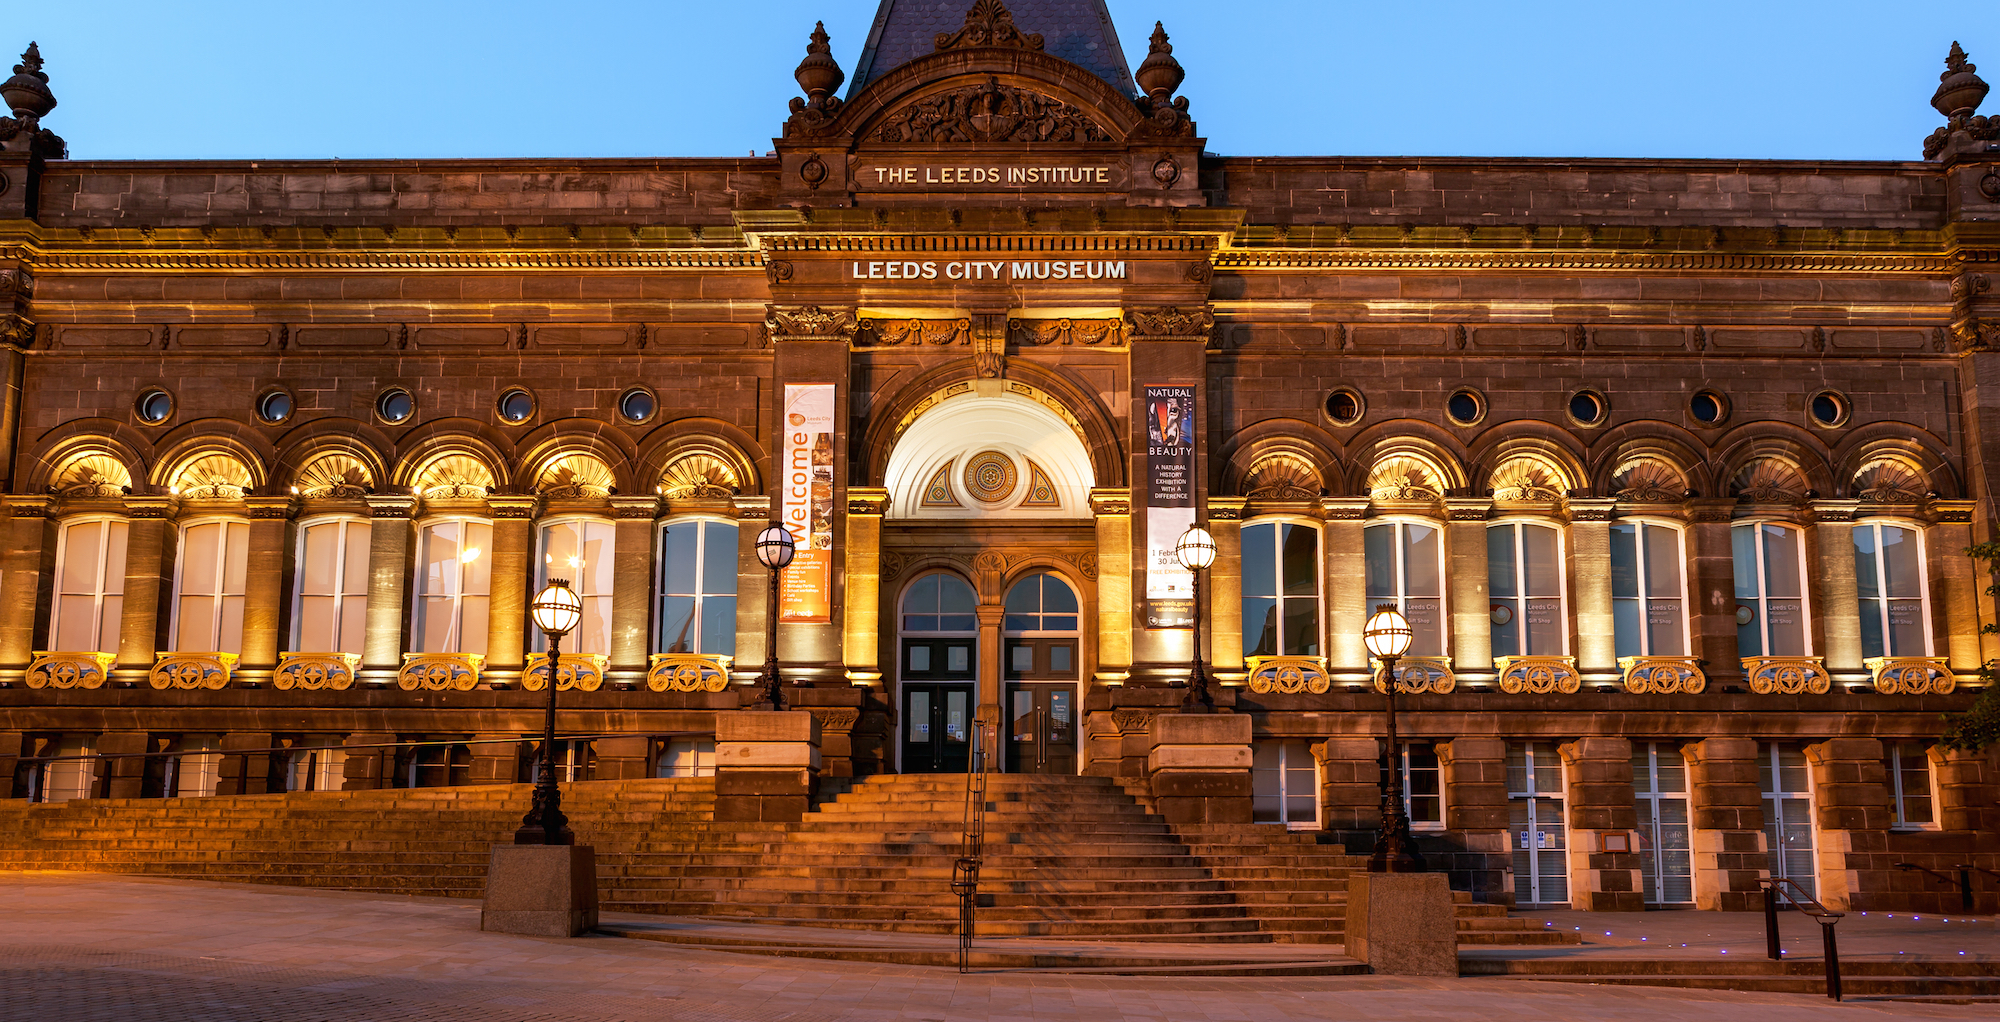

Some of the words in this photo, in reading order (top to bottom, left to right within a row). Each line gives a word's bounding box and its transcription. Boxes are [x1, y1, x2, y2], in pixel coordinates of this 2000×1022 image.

[875, 167, 918, 183] THE
[926, 167, 1001, 183] LEEDS
[1007, 167, 1109, 183] INSTITUTE
[853, 261, 938, 280] LEEDS
[945, 261, 1005, 280] CITY
[1012, 261, 1126, 280] MUSEUM
[1148, 389, 1191, 397] NATURAL
[1149, 447, 1192, 456] BEAUTY
[786, 432, 808, 543] Welcome
